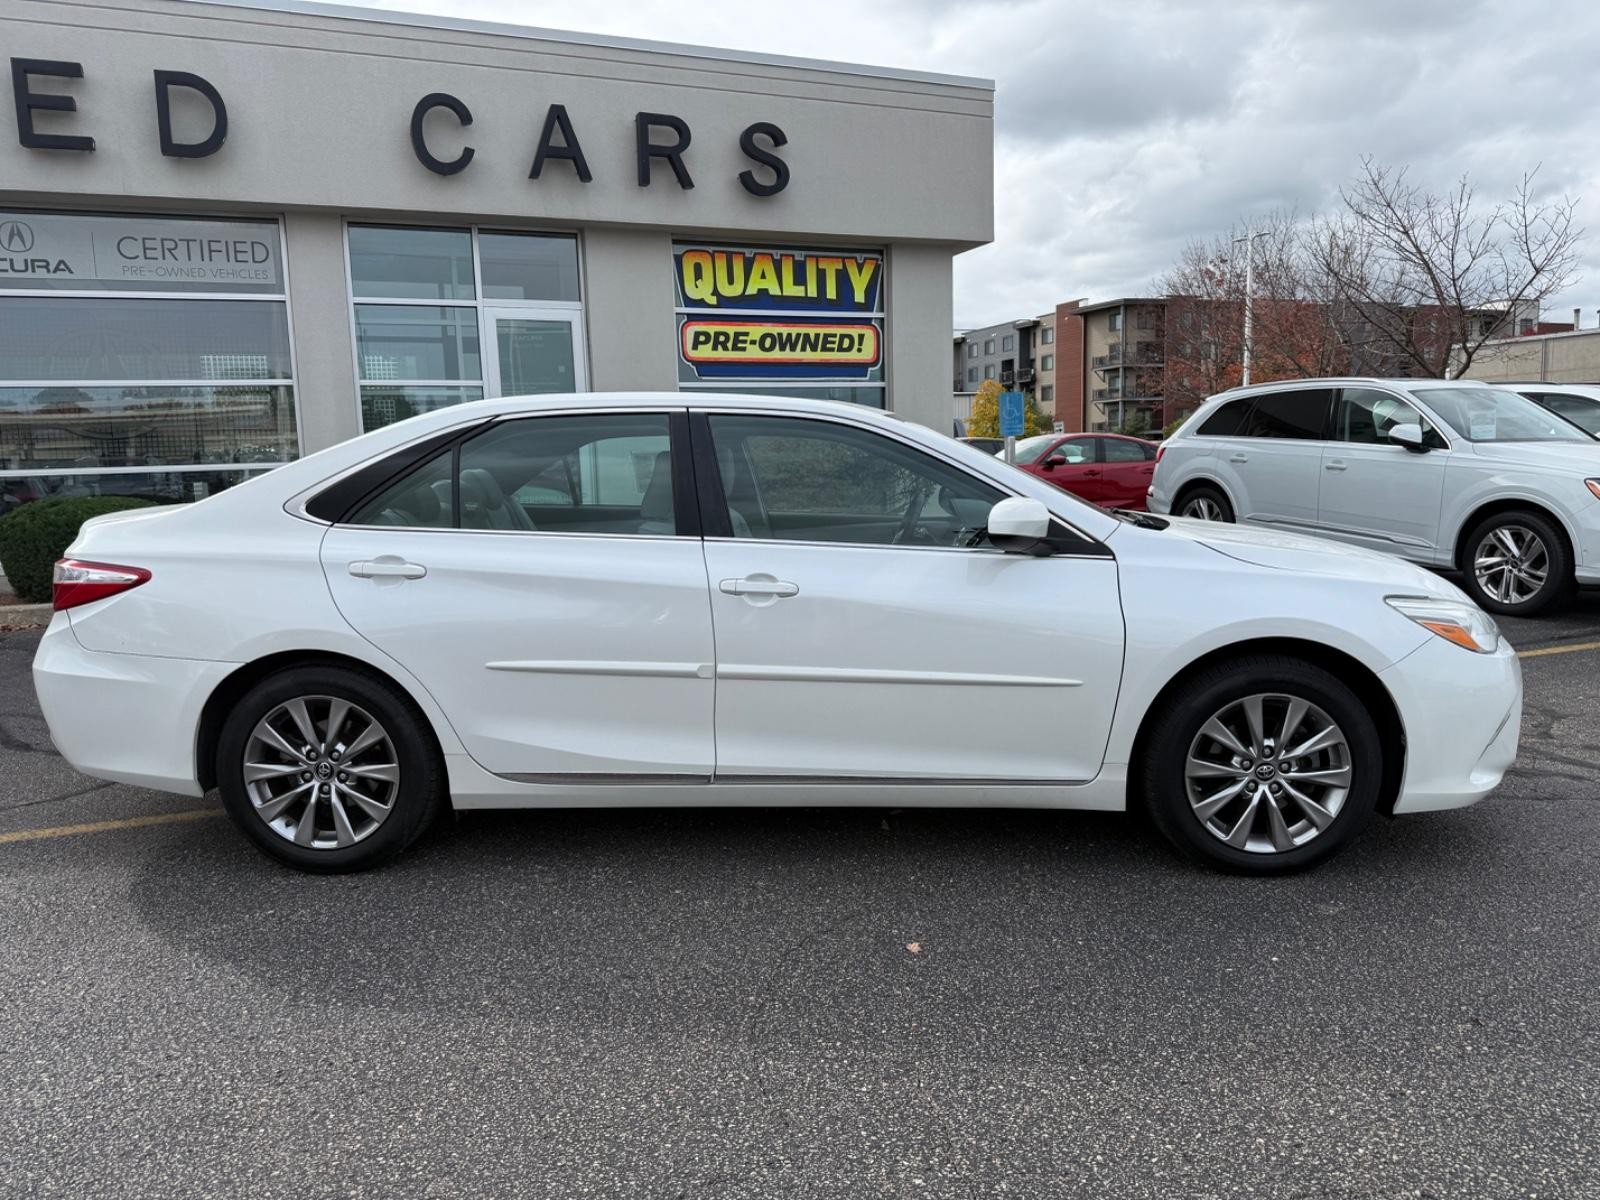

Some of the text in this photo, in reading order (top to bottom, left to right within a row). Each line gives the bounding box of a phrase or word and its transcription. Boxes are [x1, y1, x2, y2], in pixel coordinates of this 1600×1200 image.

[10, 57, 791, 197] ED CARS
[116, 236, 270, 264] CERTIFIED
[122, 265, 269, 280] PRE-OWNED VEHICLES
[681, 249, 877, 305] QUALITY
[691, 331, 866, 353] PRE-OWNED!
